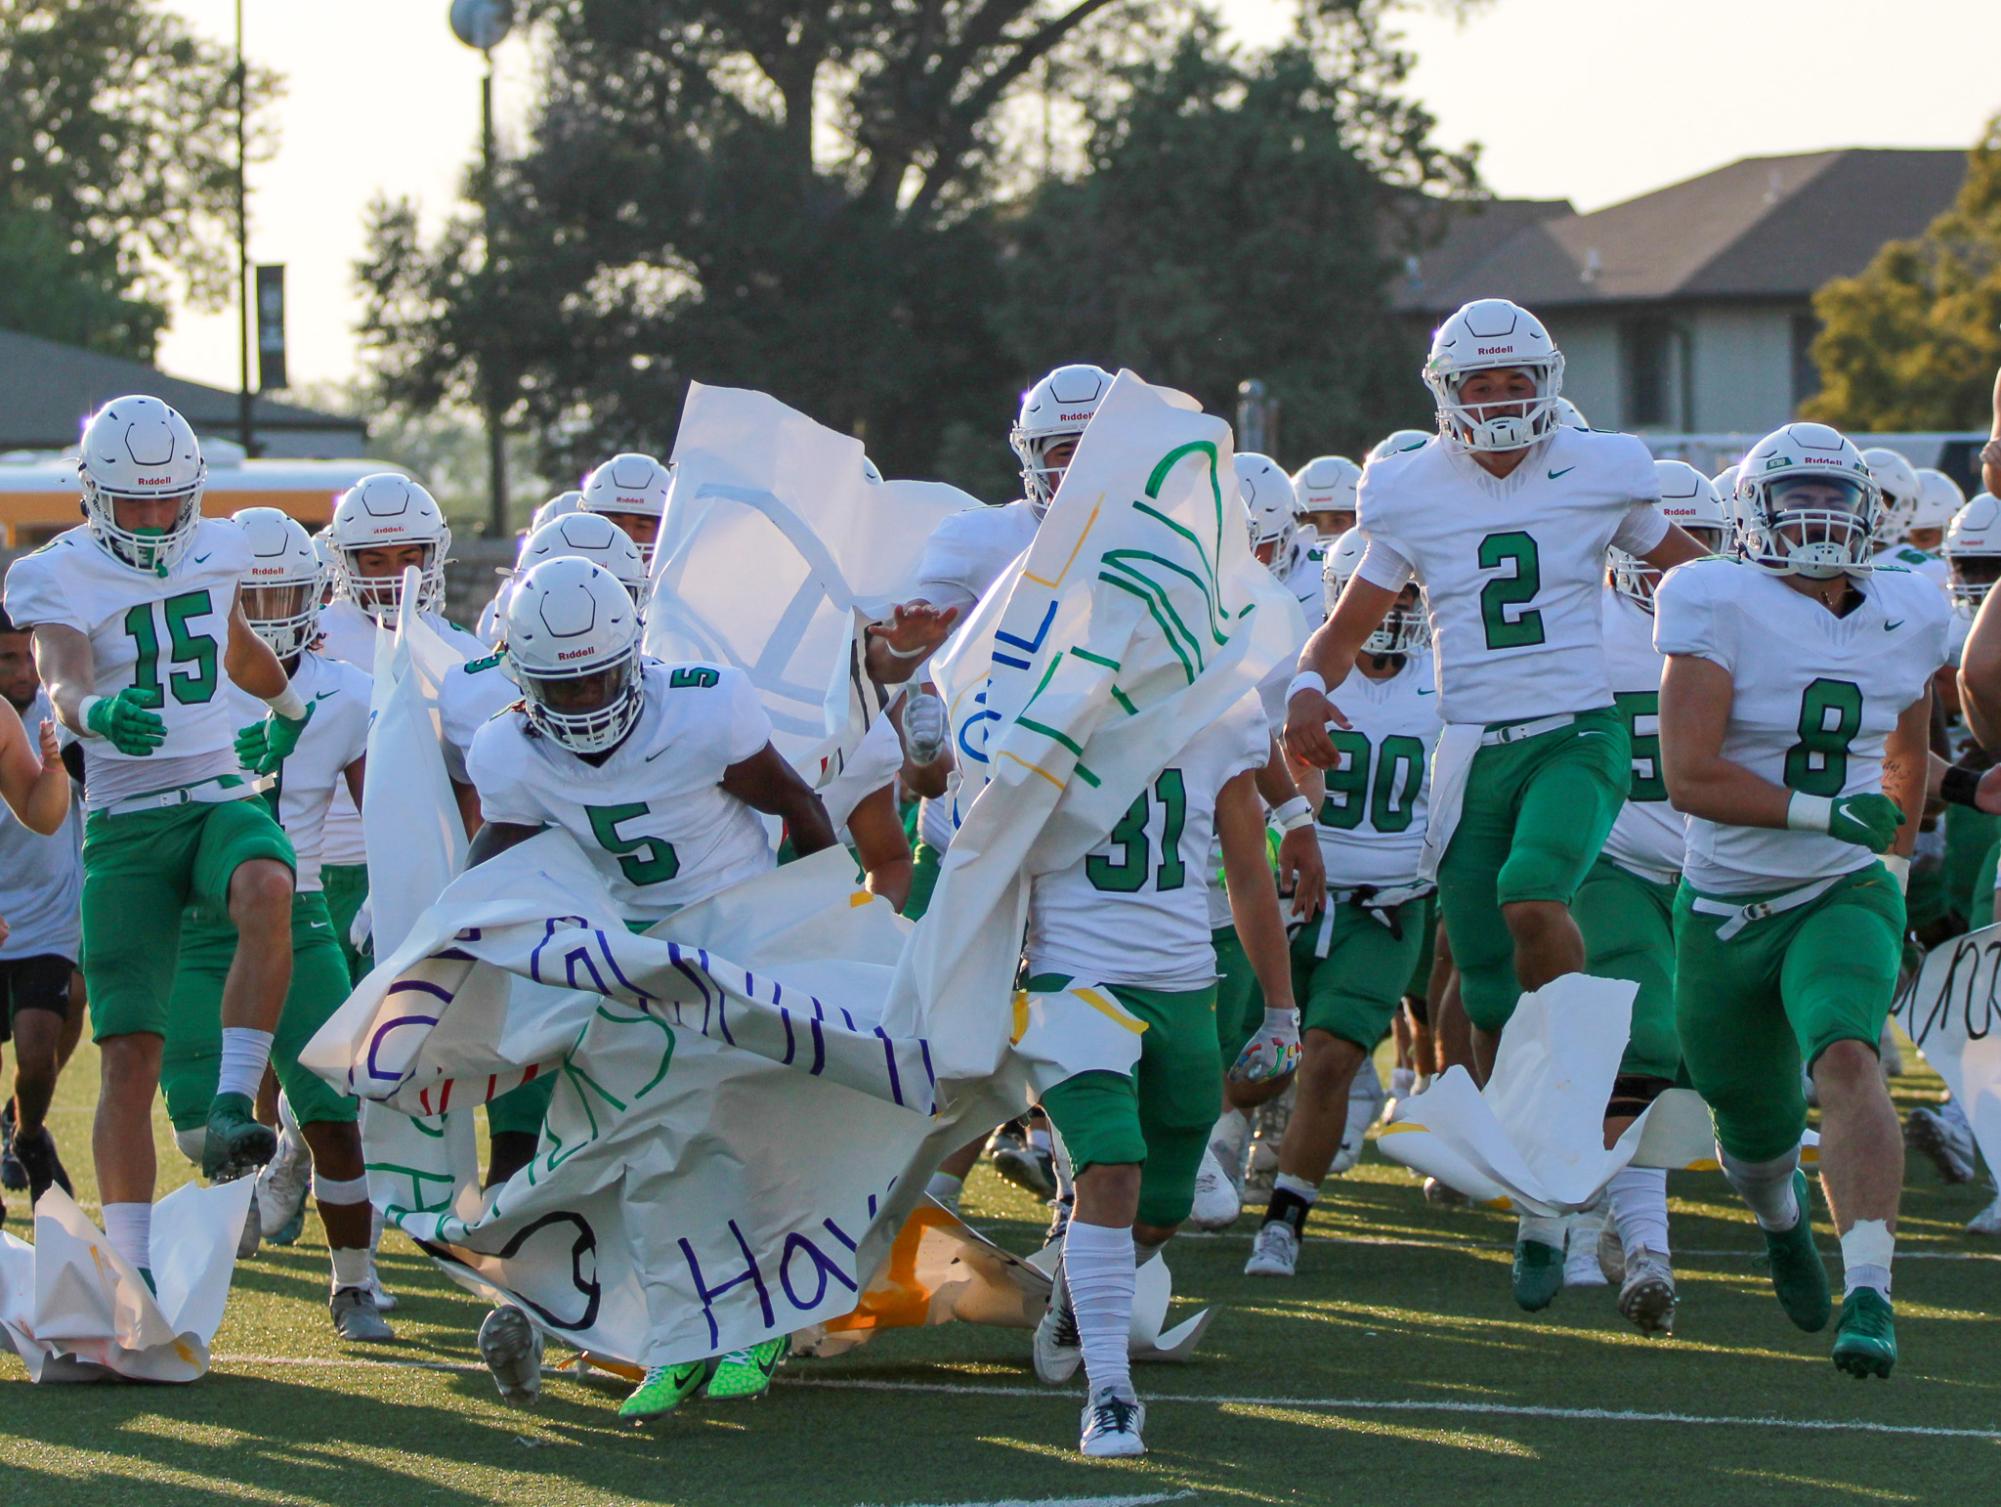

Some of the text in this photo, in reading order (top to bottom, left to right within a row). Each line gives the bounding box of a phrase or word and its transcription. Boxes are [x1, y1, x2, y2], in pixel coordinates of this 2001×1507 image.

[1477, 345, 1514, 356] Riddell
[1804, 457, 1842, 466] Riddell
[138, 476, 172, 486] Riddell
[1663, 507, 1697, 516] Riddell
[252, 566, 285, 576] Riddell
[1477, 530, 1546, 651] 2
[125, 589, 219, 709] 15
[558, 646, 595, 661] Riddell
[669, 666, 721, 689] 5
[1783, 677, 1864, 798] 8
[1317, 729, 1426, 834] 90
[1085, 767, 1187, 893] 31
[583, 801, 681, 887] 5
